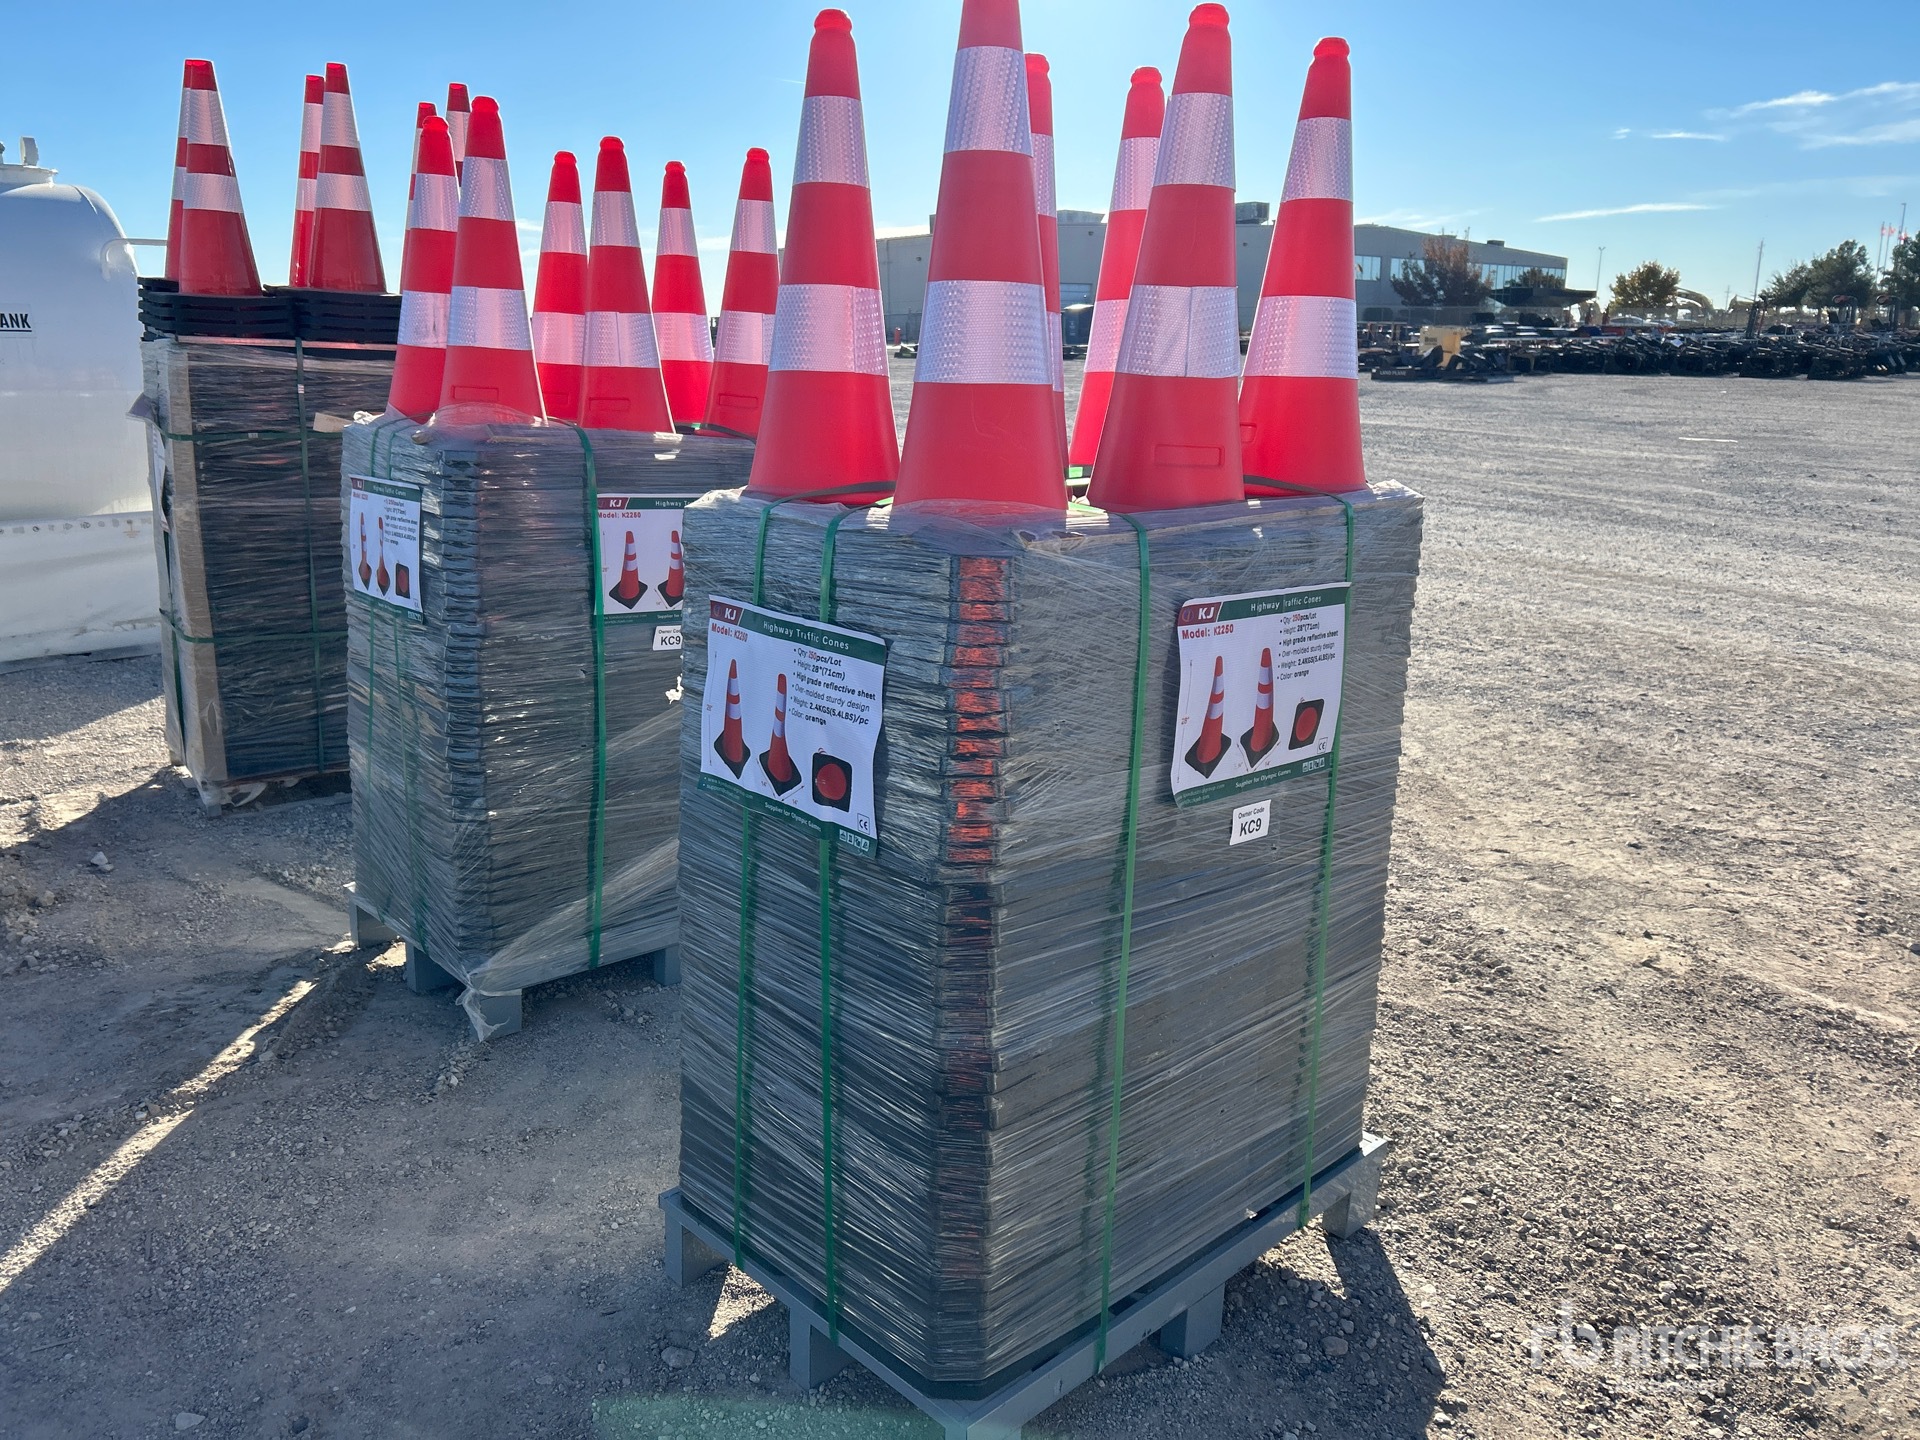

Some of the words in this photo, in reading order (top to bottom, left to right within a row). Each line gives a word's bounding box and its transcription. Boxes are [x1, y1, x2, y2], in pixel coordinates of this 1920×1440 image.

[1250, 601, 1280, 613] Highway
[1303, 595, 1321, 604] Cones
[724, 607, 737, 620] KJ
[1198, 607, 1214, 620] KJ
[711, 622, 733, 637] Model:
[763, 620, 794, 639] Highway
[796, 628, 820, 643] Traffic
[822, 636, 849, 650] Cones
[1182, 627, 1210, 639] Model:
[661, 635, 681, 646] KC9
[1282, 638, 1292, 646] High
[1293, 635, 1306, 645] grade
[1307, 633, 1326, 641] reflective
[1327, 630, 1338, 638] sheet
[796, 671, 806, 682] High
[806, 677, 822, 687] grade
[823, 681, 856, 695] reflective
[857, 689, 876, 701] sheet
[795, 683, 825, 700] Over-molded
[825, 695, 846, 707] sturdy
[846, 700, 870, 712] design
[805, 714, 827, 726] orange
[1260, 771, 1277, 783] Olympic
[1277, 768, 1291, 778] Games
[764, 801, 783, 814] Supplier
[783, 808, 791, 816] for
[790, 812, 807, 826] Olympic
[807, 820, 822, 832] Games
[1238, 810, 1253, 820] Owner
[1253, 807, 1265, 816] Code
[1239, 818, 1262, 837] KC9
